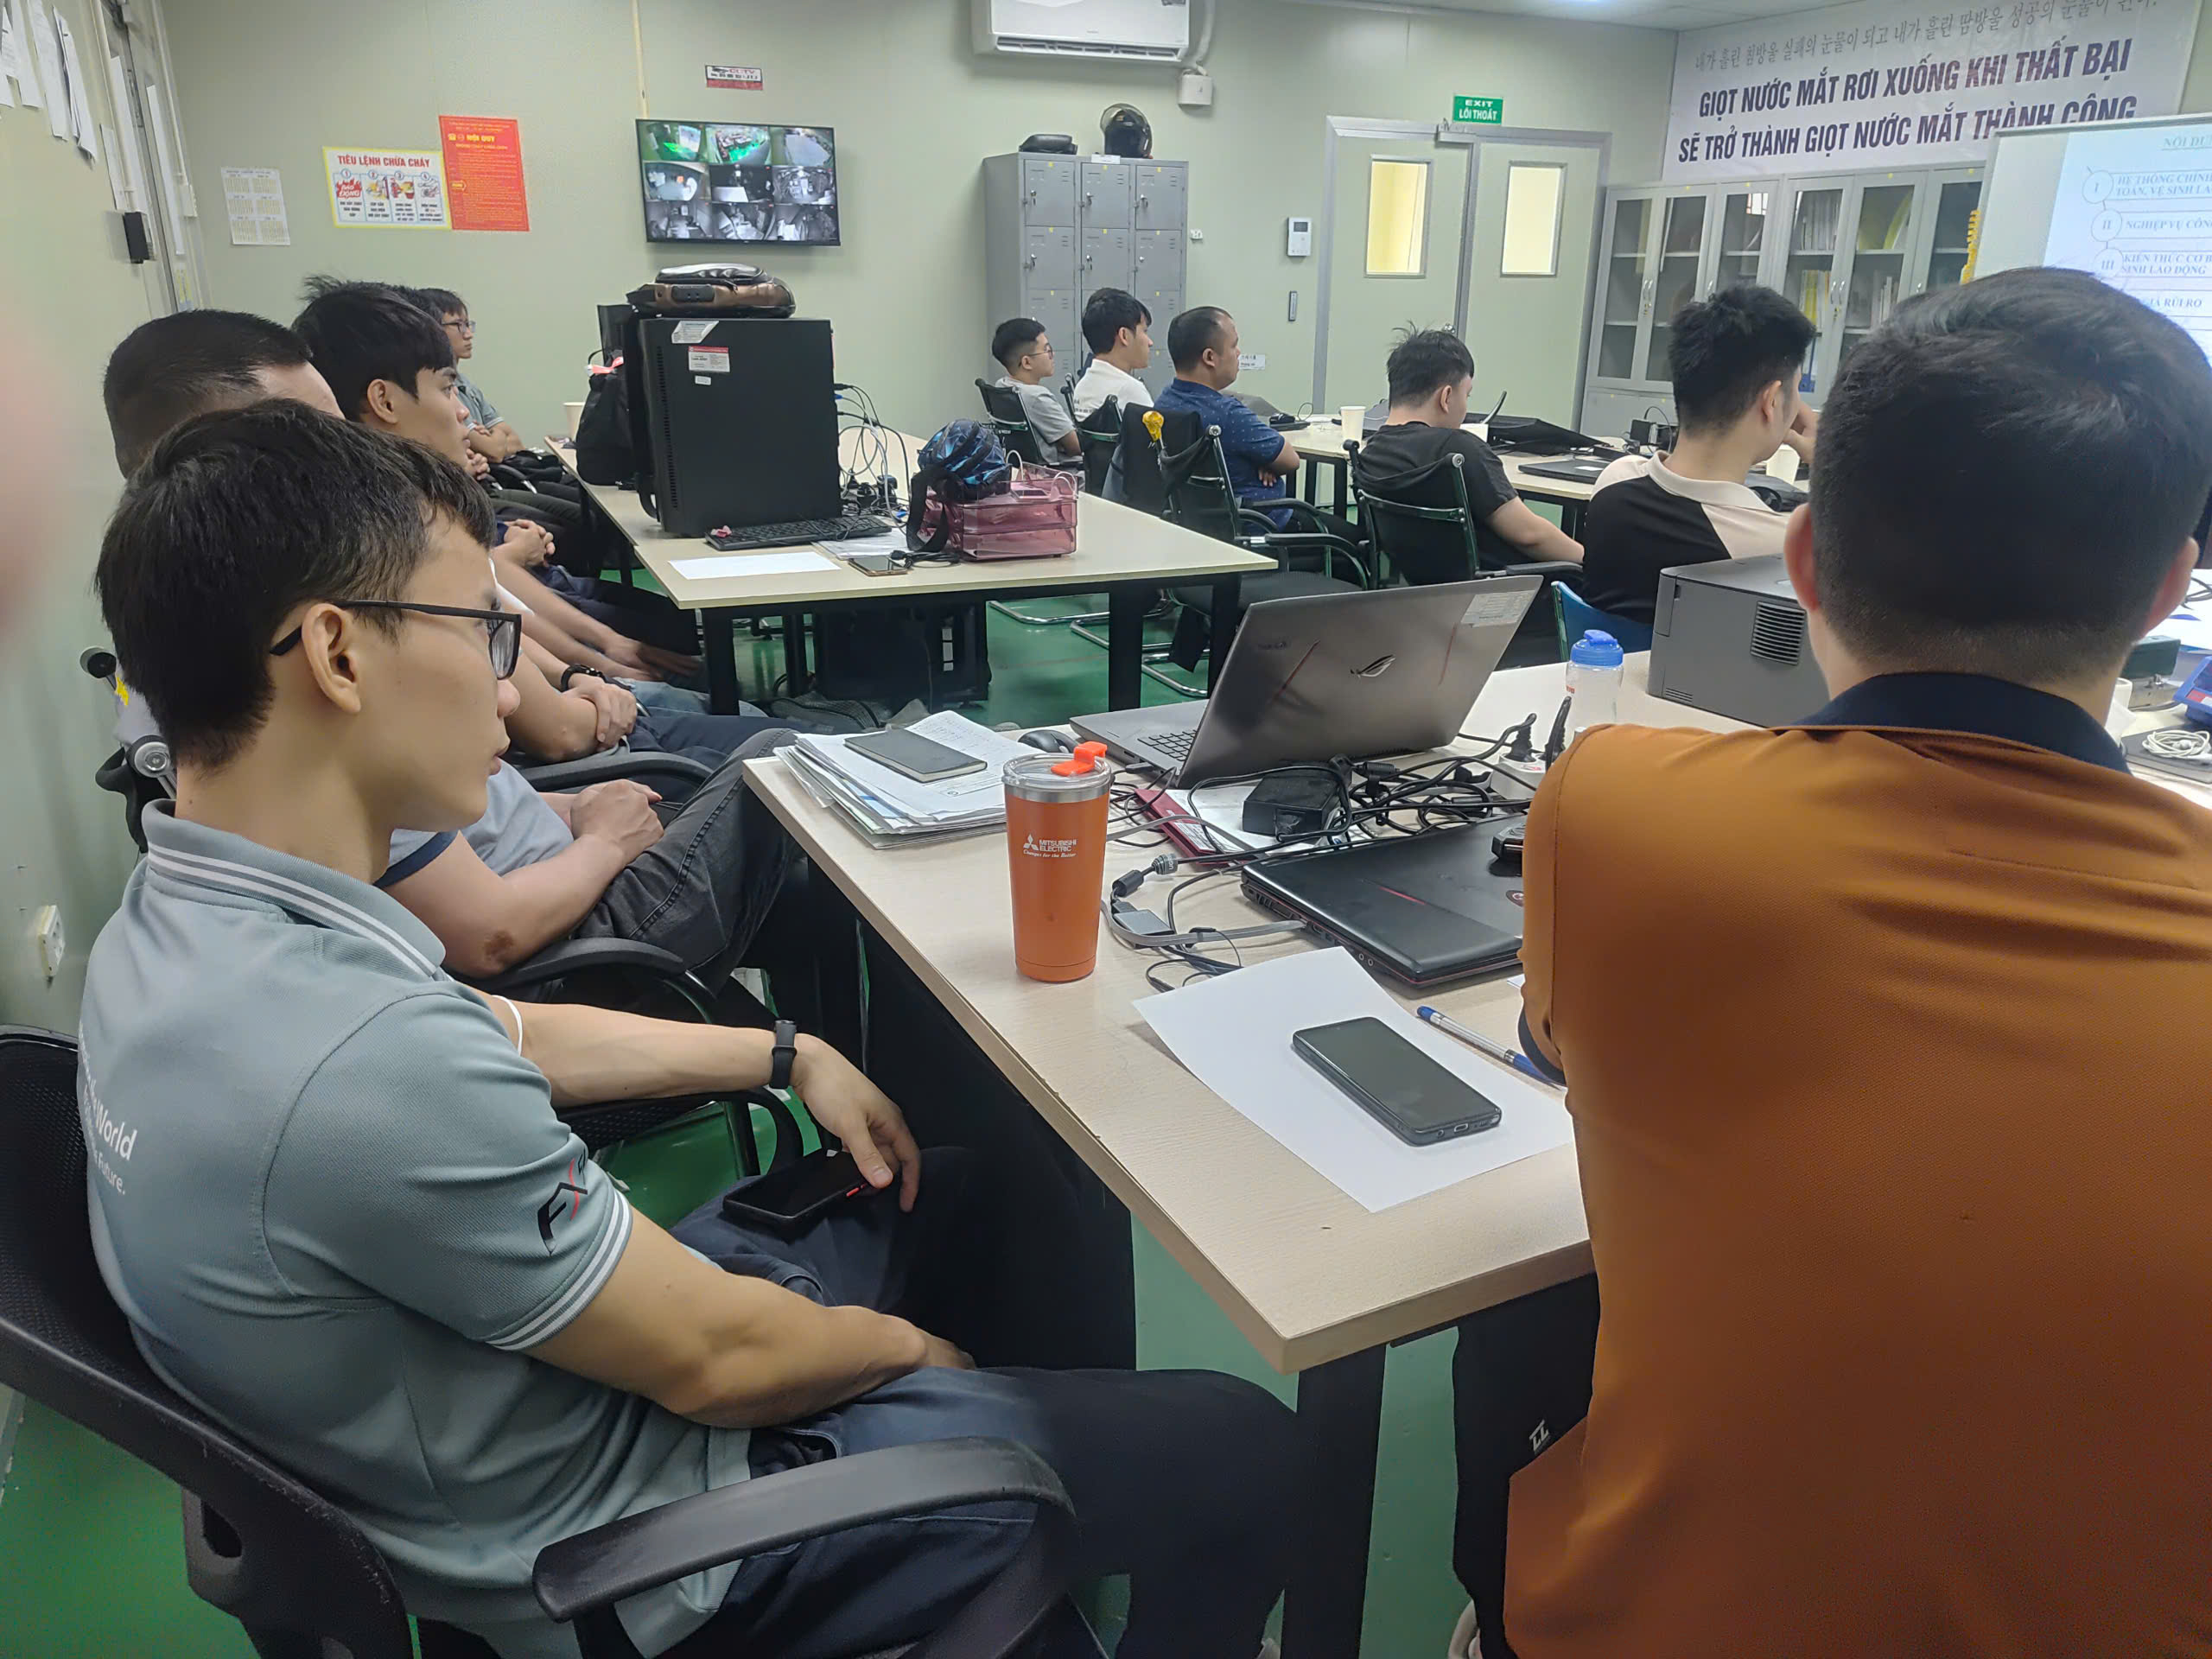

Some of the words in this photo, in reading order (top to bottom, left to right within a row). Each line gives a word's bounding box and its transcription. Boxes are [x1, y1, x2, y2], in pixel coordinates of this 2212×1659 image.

[1862, 24, 1889, 48] 되고
[1894, 18, 1921, 43] 내가
[1925, 13, 1954, 41] 흘린
[1960, 6, 2003, 35] 땀방울
[2012, 0, 2056, 29] 성공의
[1699, 88, 1738, 121] GIỌT
[1741, 77, 1791, 113] NƯỚC
[1796, 67, 1840, 107] MẮT
[1843, 67, 1879, 102] RƠI
[1883, 53, 1961, 98] XUỐNG
[1965, 54, 2008, 88] KHI
[2015, 35, 2079, 83] THẤT
[2082, 38, 2133, 81] BẠI
[1678, 132, 1700, 162] SẼ
[1705, 124, 1738, 161] TRỞ
[1742, 124, 1801, 157] THÀNH
[1805, 124, 1849, 158] GIỌT
[1853, 112, 1911, 149] NƯỚC
[1916, 102, 1967, 144] MẮT
[95, 1102, 138, 1161] World
